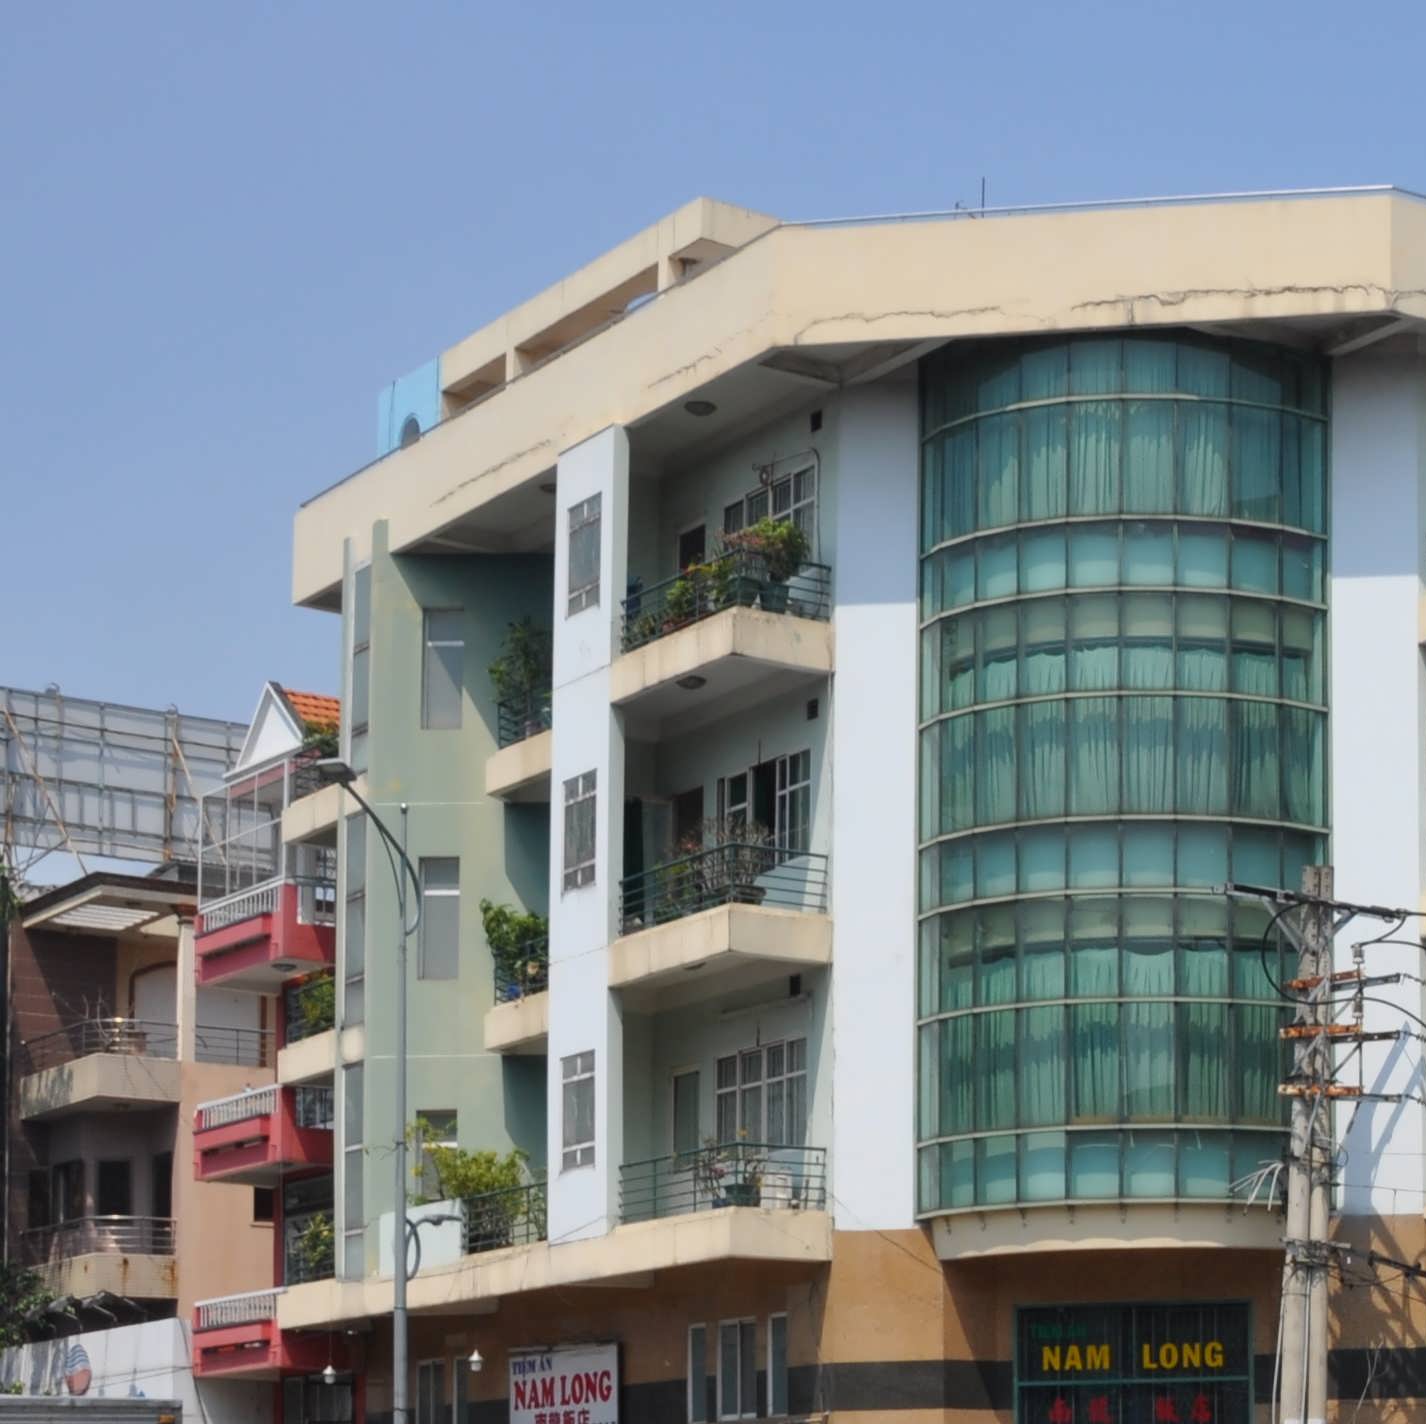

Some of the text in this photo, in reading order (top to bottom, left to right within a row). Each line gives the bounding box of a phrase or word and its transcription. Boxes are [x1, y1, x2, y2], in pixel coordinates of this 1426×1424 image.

[1042, 1341, 1224, 1372] NAM LONG
[513, 1370, 612, 1411] NAM LONG
